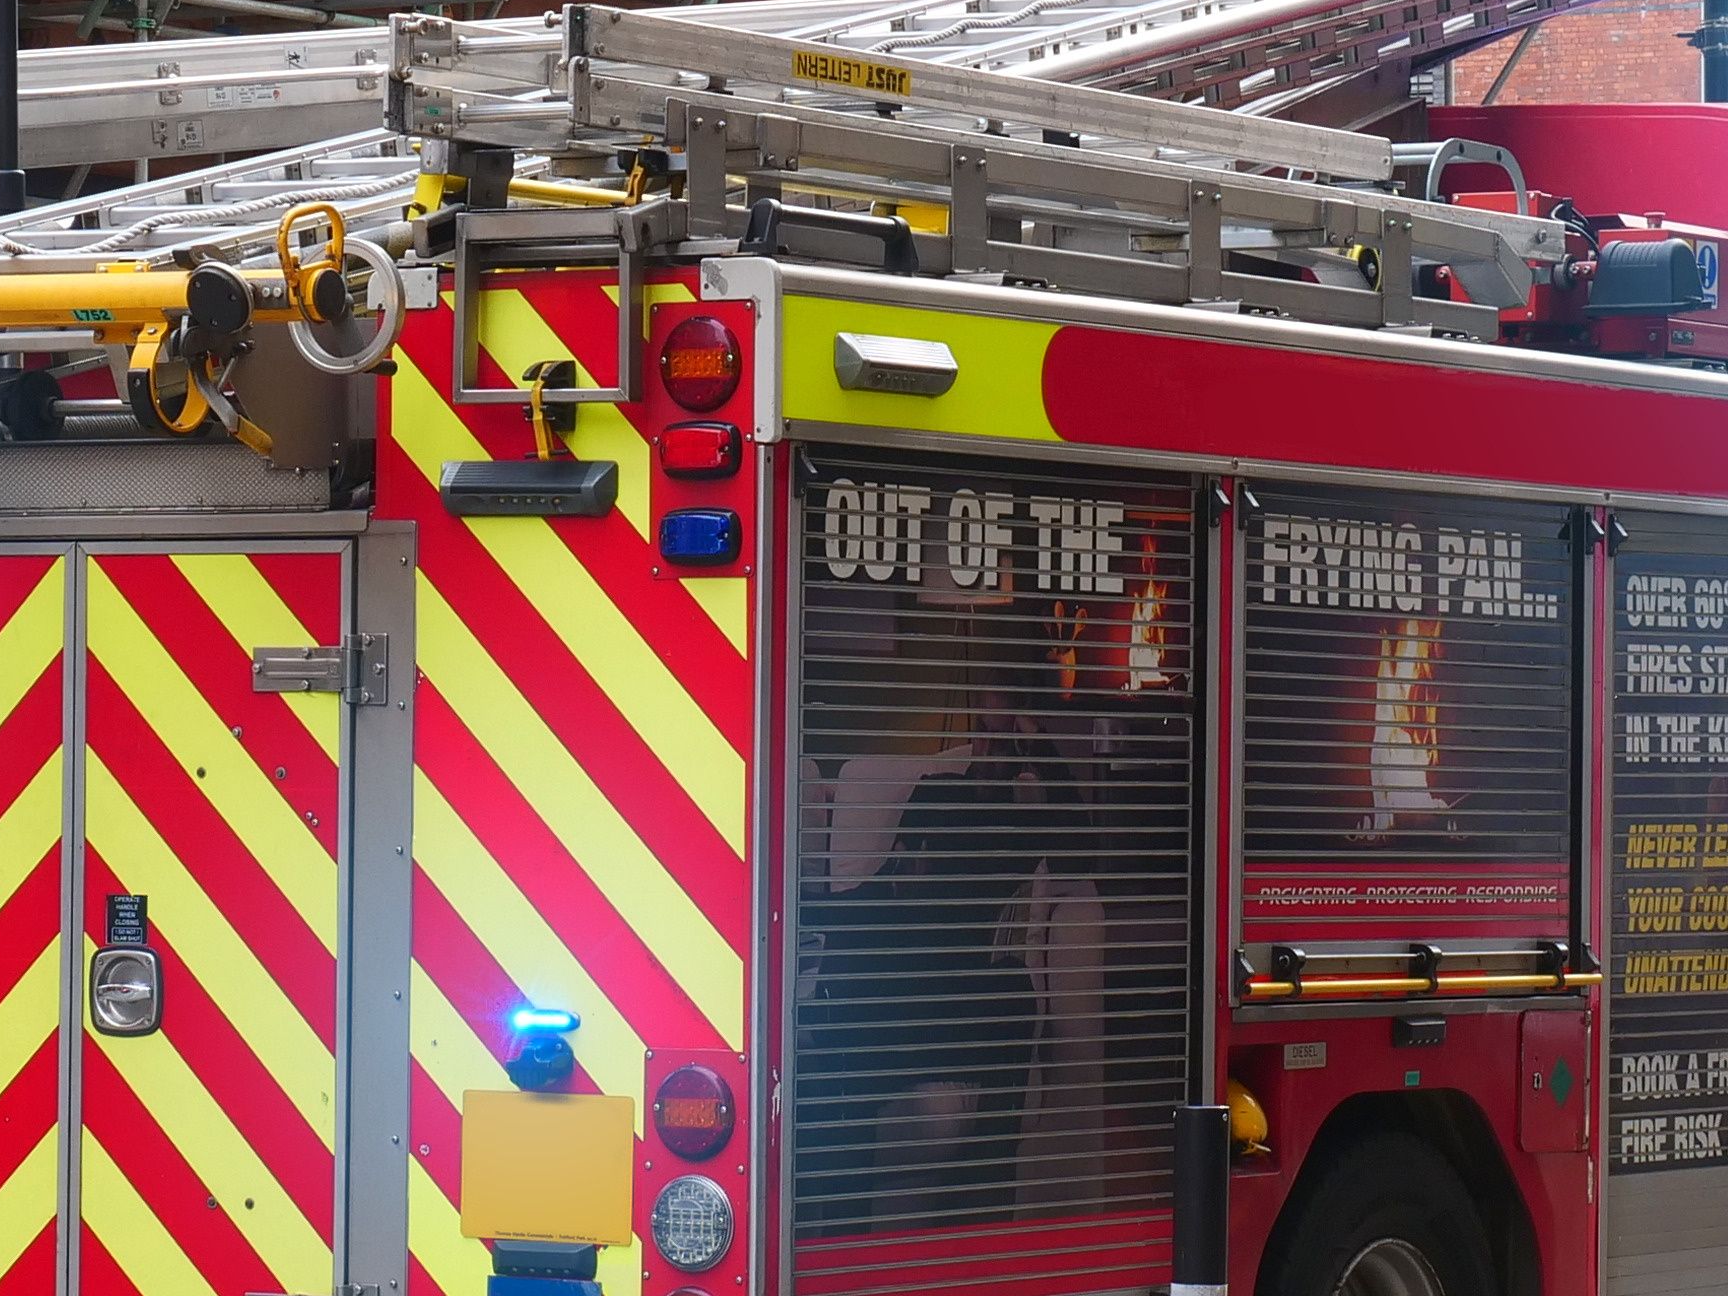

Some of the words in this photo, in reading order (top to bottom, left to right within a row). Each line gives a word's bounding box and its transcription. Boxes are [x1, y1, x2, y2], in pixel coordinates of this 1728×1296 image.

[866, 65, 907, 94] JUST
[825, 478, 931, 581] OUT
[948, 488, 1014, 586] OF
[1030, 496, 1124, 593] THE
[1263, 513, 1422, 611] FRYING
[1438, 527, 1557, 618] PAN...
[1626, 575, 1687, 627] OVER
[1627, 644, 1693, 693] FIRES
[1626, 716, 1650, 762] IN
[1657, 716, 1701, 763] THE
[1626, 824, 1698, 868] NEVER
[1628, 887, 1684, 932] YOUR
[1292, 1045, 1318, 1058] DIESEL
[1622, 1054, 1680, 1100] BOOK
[1685, 1053, 1700, 1097] A
[1622, 1117, 1667, 1164] FIRE
[1674, 1113, 1723, 1160] RISK
